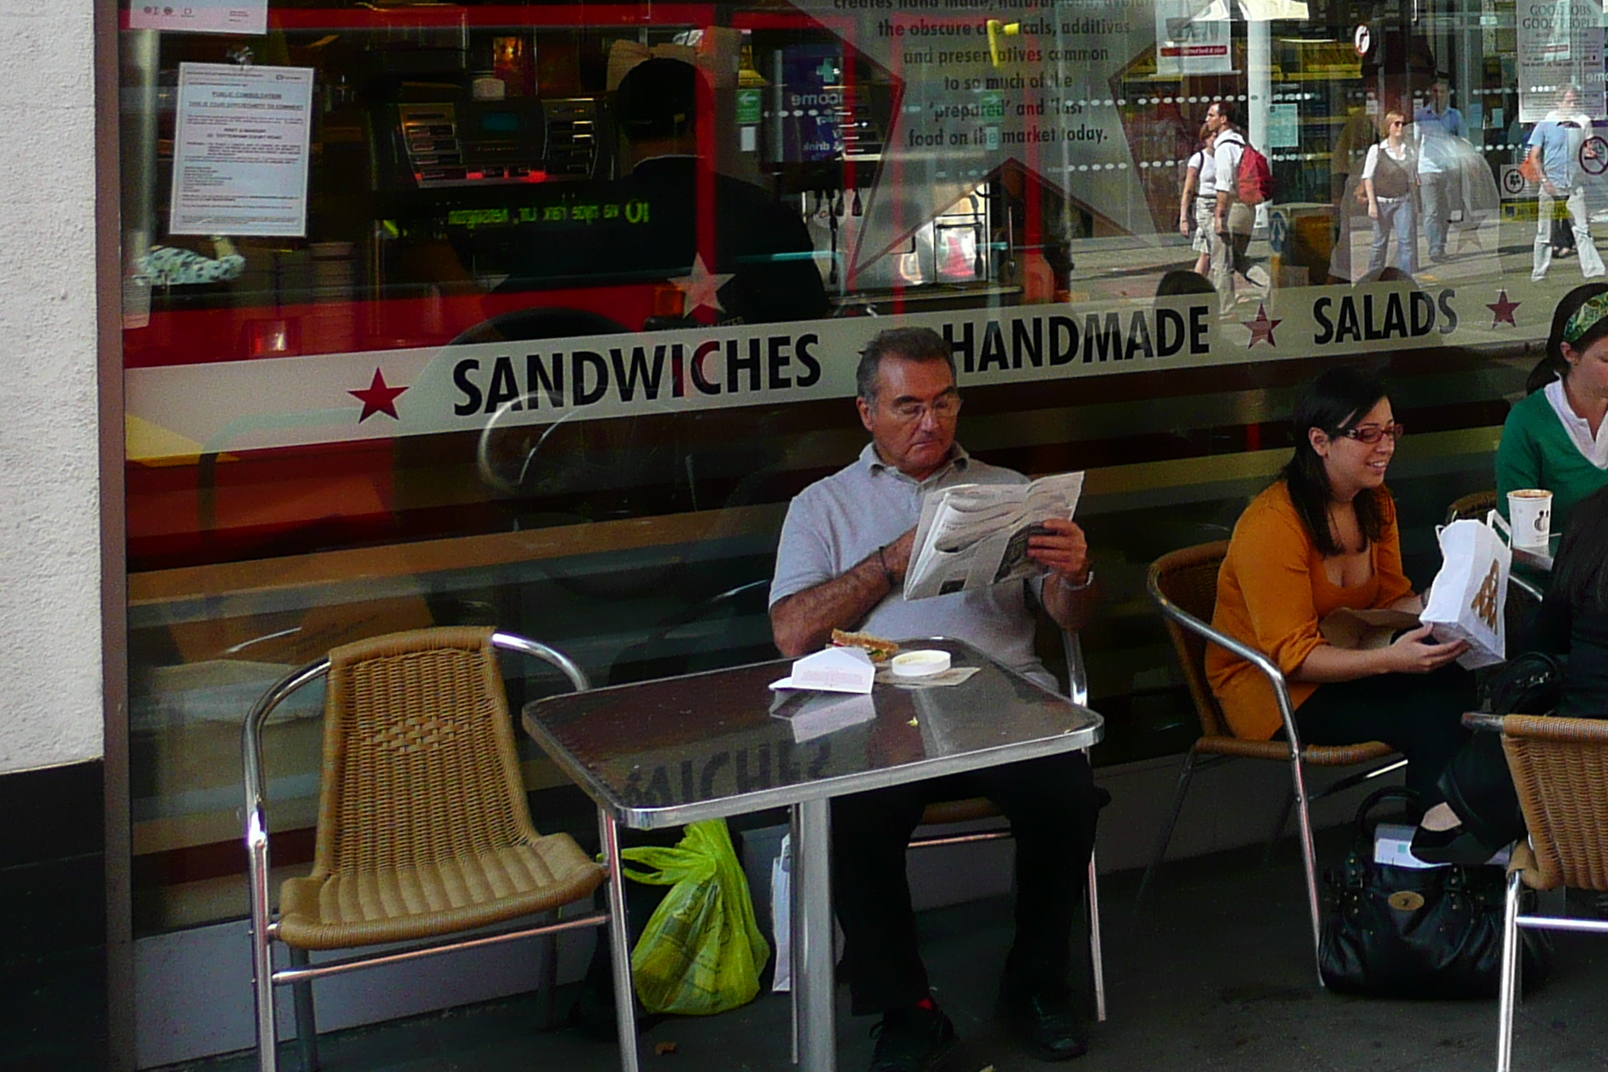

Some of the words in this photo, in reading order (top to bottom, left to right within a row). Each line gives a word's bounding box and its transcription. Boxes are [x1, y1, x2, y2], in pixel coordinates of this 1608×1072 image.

[878, 18, 904, 36] the
[909, 18, 970, 36] obscure
[975, 18, 1057, 38] cheicals,
[1062, 17, 1131, 35] additives
[904, 47, 933, 65] and
[1048, 48, 1109, 63] common
[944, 75, 960, 90] to
[964, 77, 981, 90] so
[985, 75, 1025, 90] much
[1028, 74, 1045, 89] of
[1016, 100, 1044, 116] and
[909, 127, 945, 147] food
[949, 131, 968, 146] on
[973, 126, 997, 145] the
[1001, 125, 1056, 145] market
[1062, 123, 1109, 144] today.
[1313, 289, 1458, 345] SALADS
[944, 304, 1211, 375] HANDMADE
[453, 333, 822, 418] SANDWICHES
